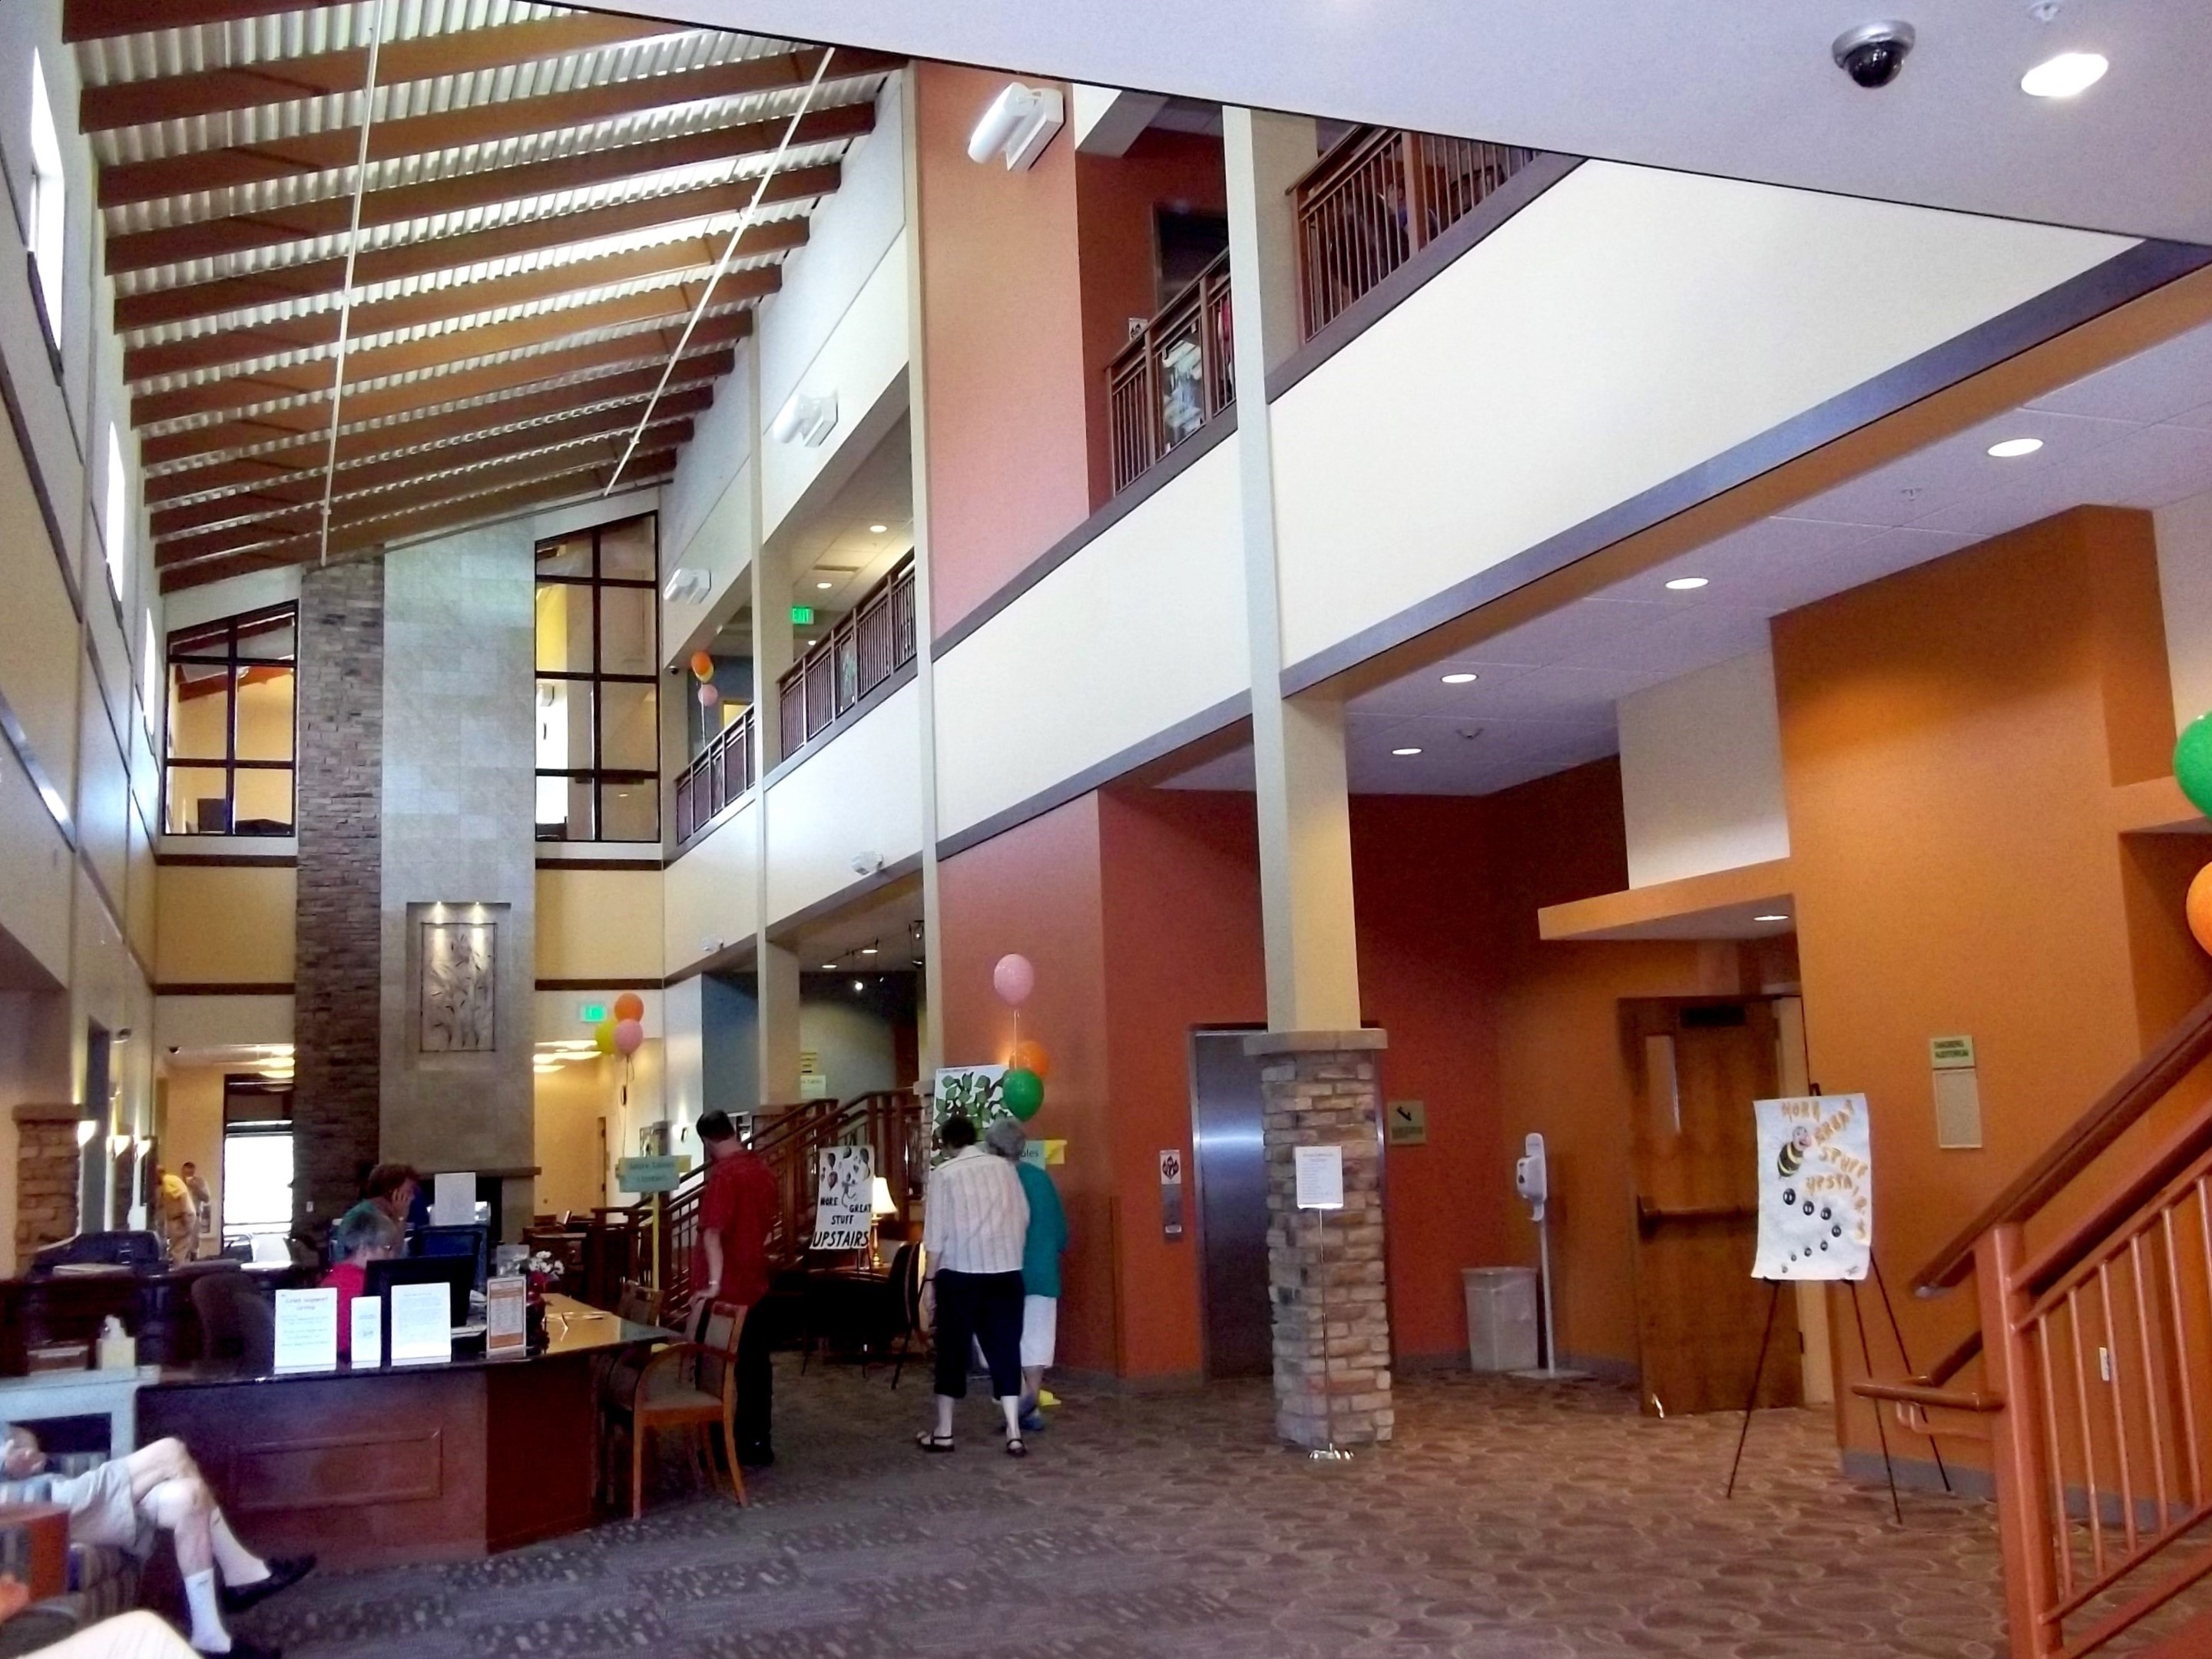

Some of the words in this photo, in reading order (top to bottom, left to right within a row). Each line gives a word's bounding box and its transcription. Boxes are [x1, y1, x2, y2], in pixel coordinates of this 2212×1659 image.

[849, 1204, 872, 1213] GREAT
[830, 1215, 854, 1225] STUFF
[813, 1230, 869, 1247] UPSTAIRS
